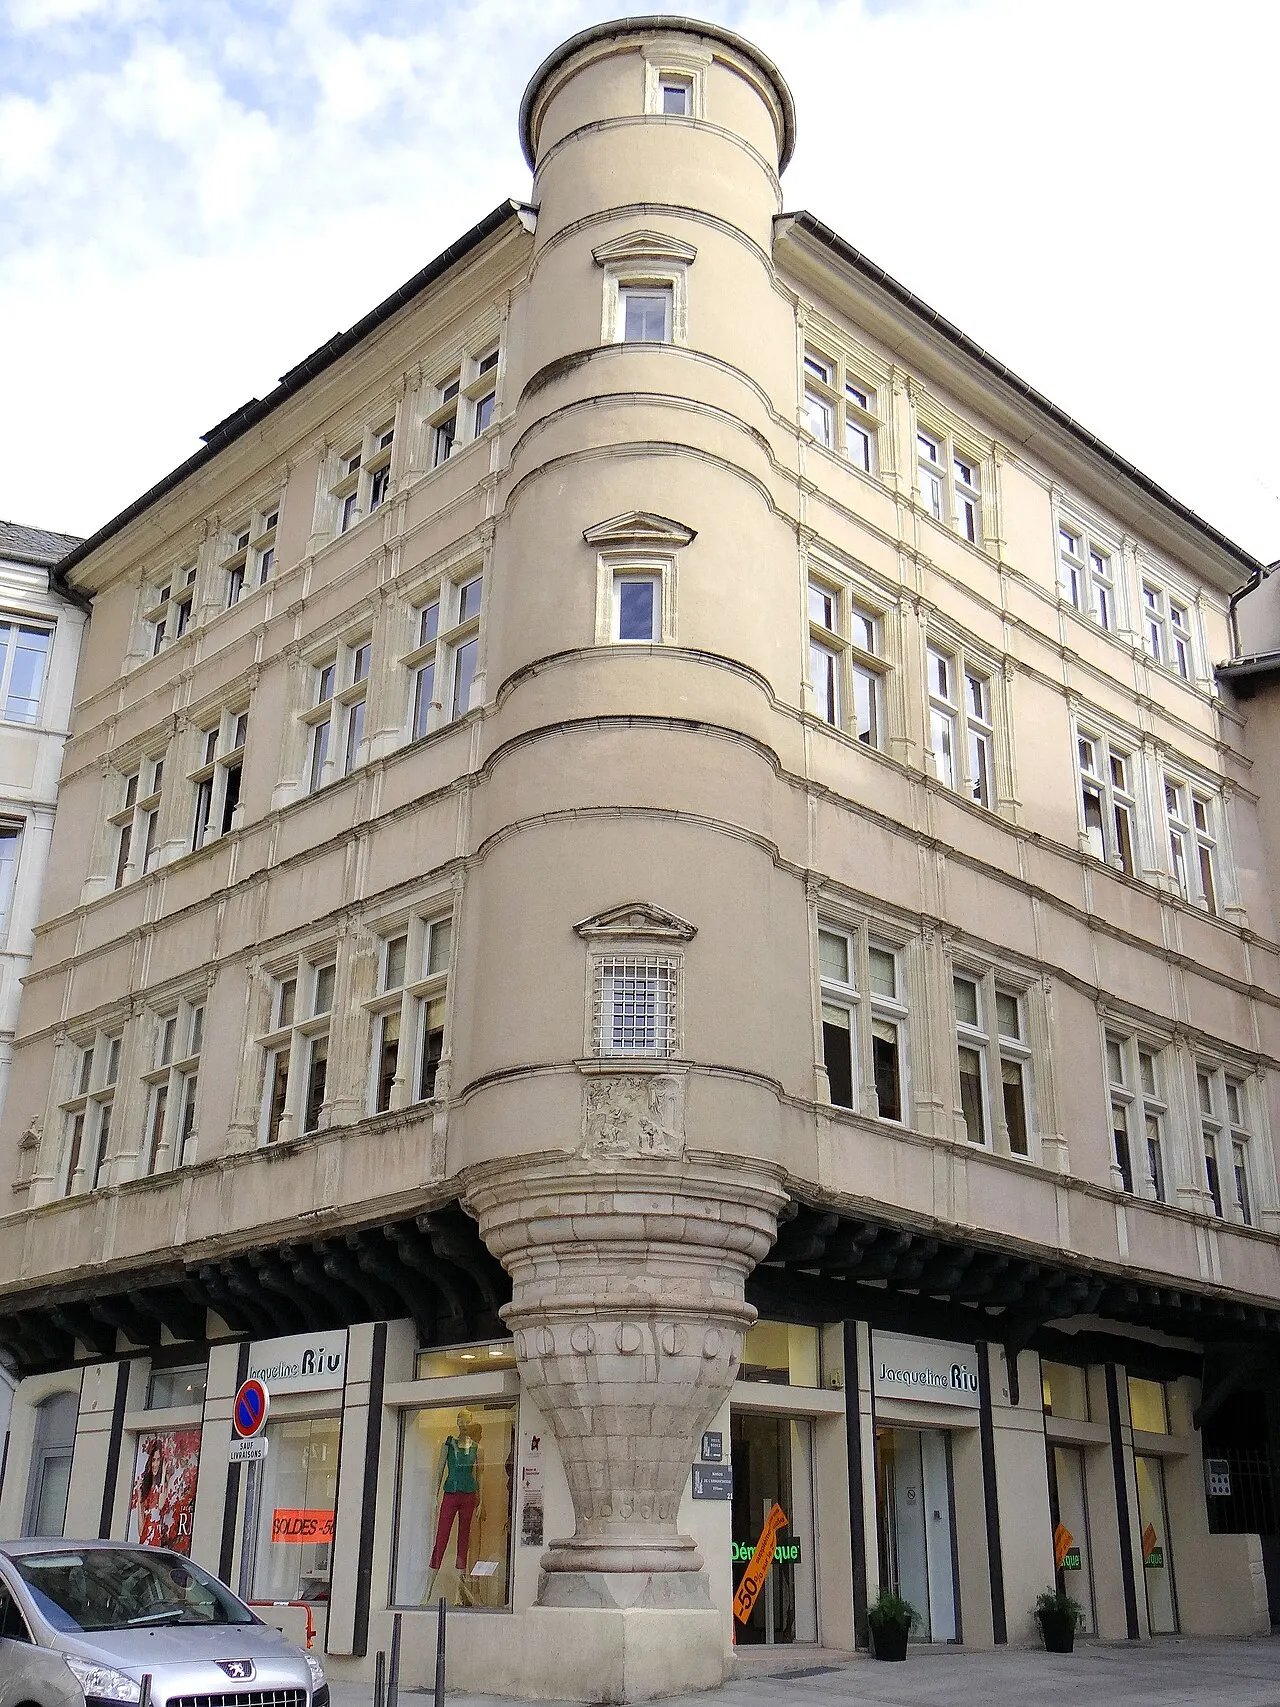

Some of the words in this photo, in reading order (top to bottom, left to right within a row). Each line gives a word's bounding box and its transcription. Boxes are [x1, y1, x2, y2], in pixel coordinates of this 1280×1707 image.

[301, 1348, 341, 1375] Riu
[880, 1363, 949, 1386] Jacqueline
[950, 1363, 978, 1391] Riu
[230, 1450, 262, 1460] LIVRAISONS
[240, 1442, 254, 1450] SAUF
[273, 1518, 318, 1535] SOLDES
[731, 1541, 798, 1563] Démque
